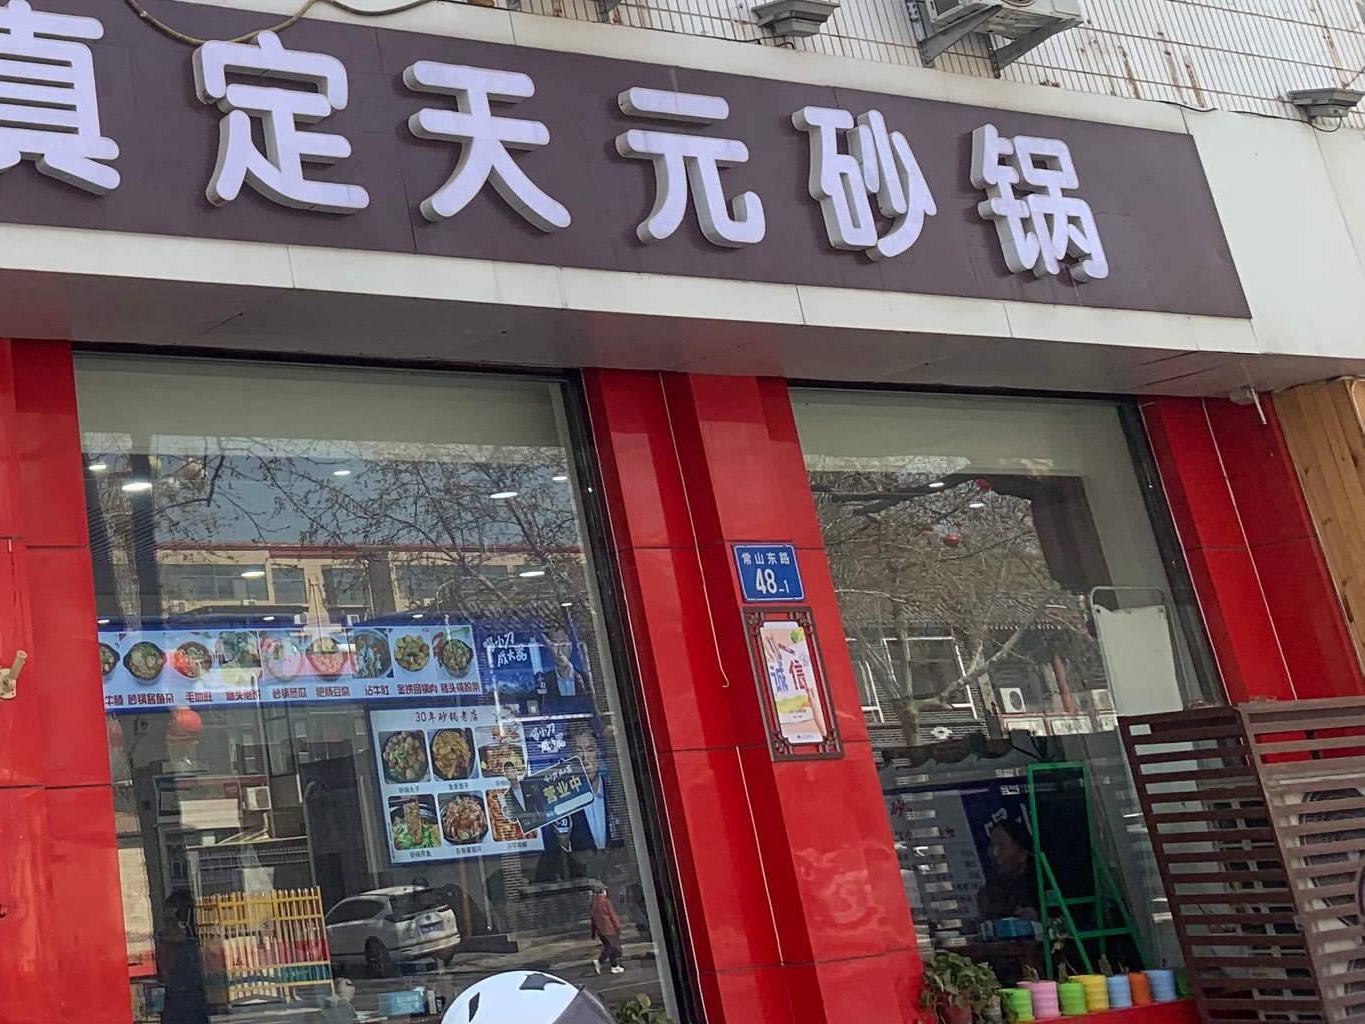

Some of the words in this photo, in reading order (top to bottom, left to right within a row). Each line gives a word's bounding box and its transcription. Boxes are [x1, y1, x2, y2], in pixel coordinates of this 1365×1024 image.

[740, 551, 791, 565] 常山东路
[770, 659, 808, 693] 诚信
[415, 709, 479, 723] 30年砂锅老店
[542, 775, 583, 804] 营业中
